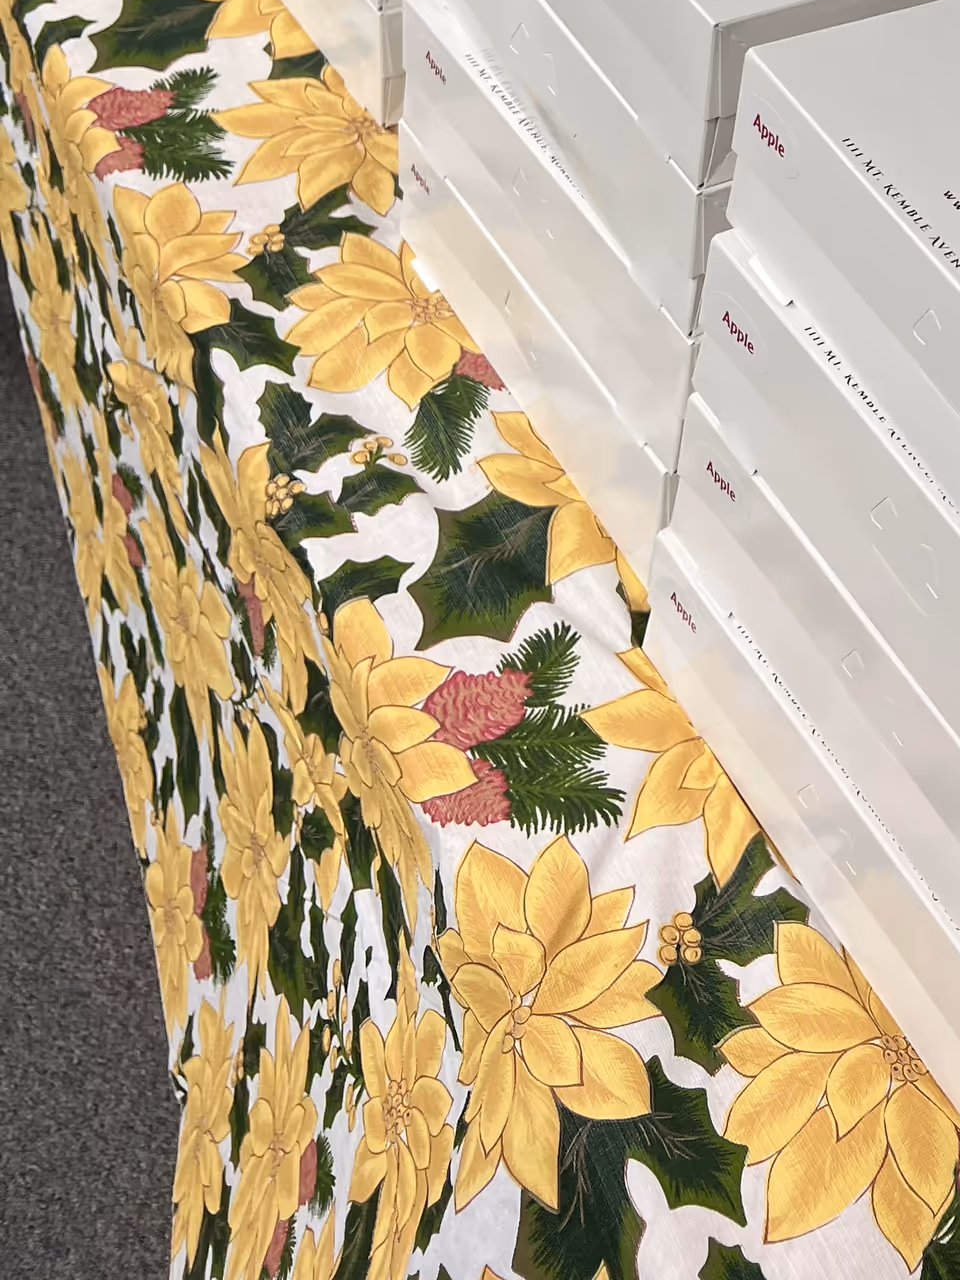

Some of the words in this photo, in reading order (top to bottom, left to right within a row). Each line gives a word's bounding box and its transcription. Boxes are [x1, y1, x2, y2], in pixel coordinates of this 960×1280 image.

[425, 50, 447, 85] Apple
[491, 84, 521, 116] KEMBLE
[752, 113, 786, 158] Apple
[410, 163, 431, 196] Apple
[842, 137, 864, 157] 1111
[862, 158, 886, 182] MT.
[883, 183, 931, 233] KEMBLE
[721, 311, 756, 355] Apple
[804, 326, 825, 346] 1111
[706, 461, 737, 503] Apple
[670, 592, 698, 634] Apple
